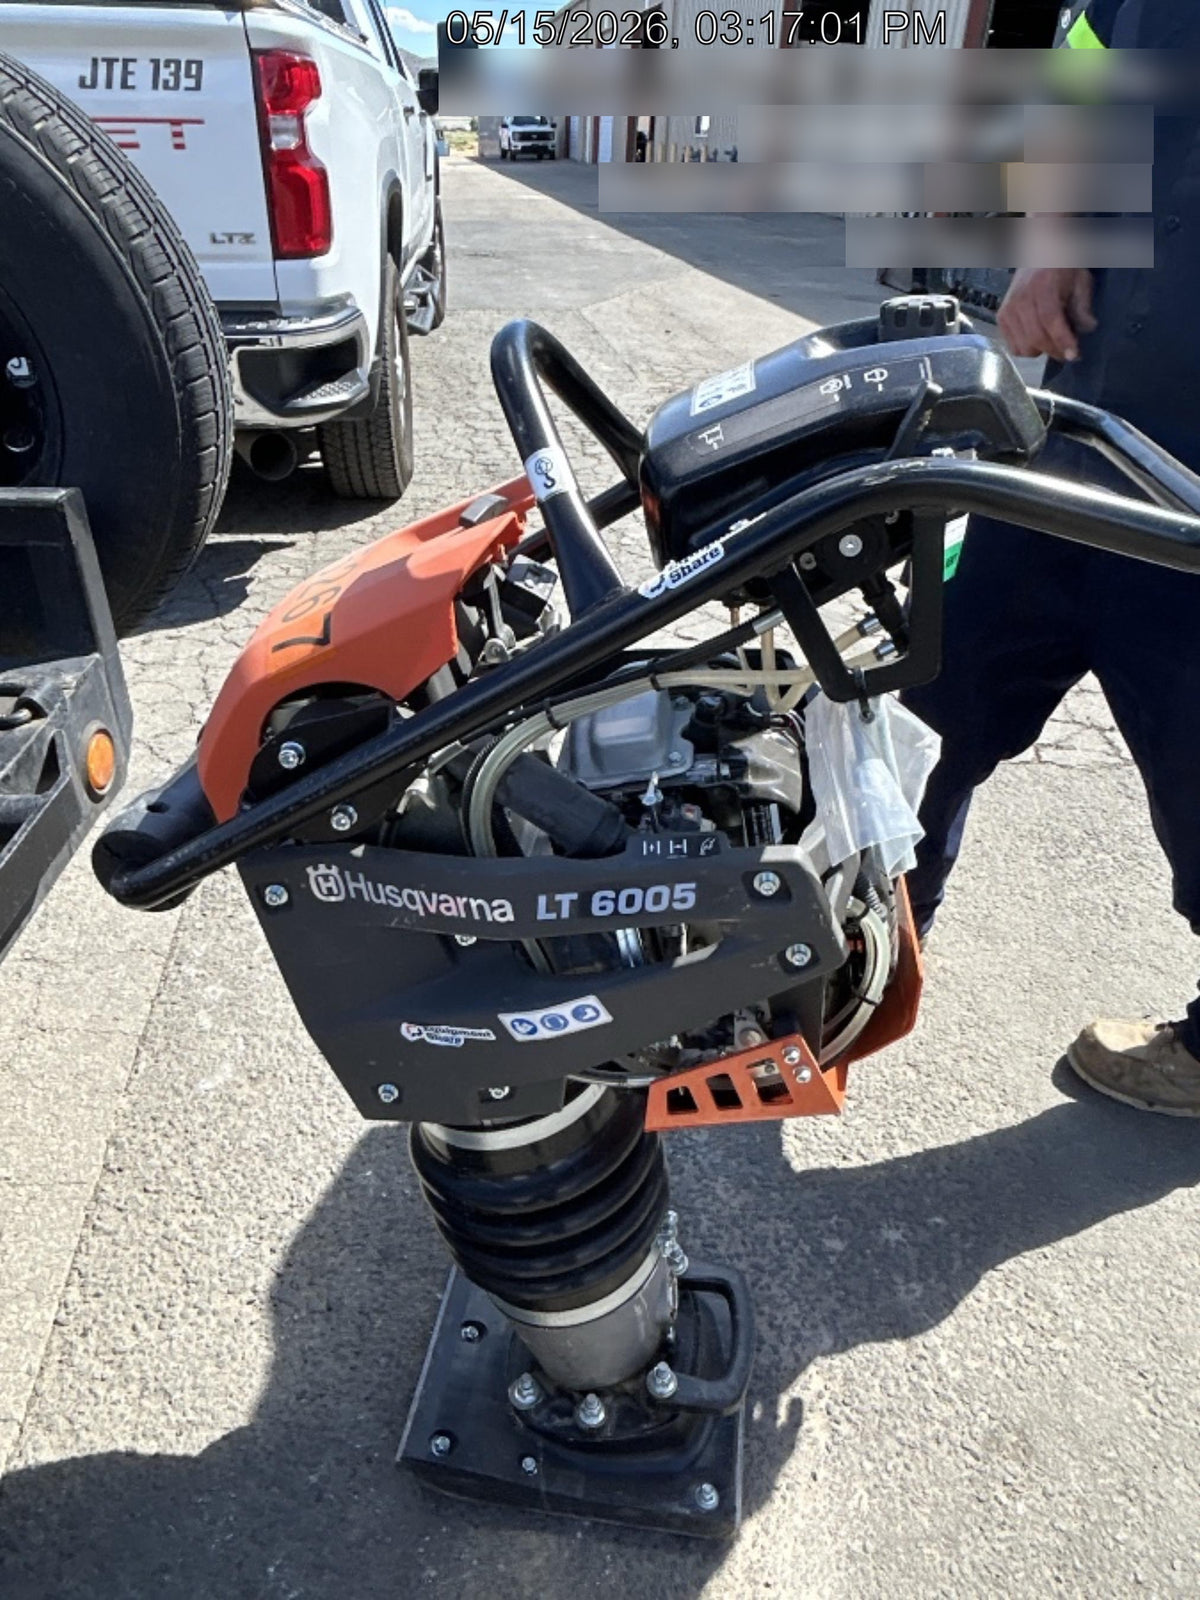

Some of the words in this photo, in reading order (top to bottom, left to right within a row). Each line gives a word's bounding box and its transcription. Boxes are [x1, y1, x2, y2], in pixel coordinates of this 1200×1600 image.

[78, 58, 136, 90] JTE
[151, 58, 204, 91] 139
[668, 547, 720, 584] Share
[344, 870, 515, 923] Husqvarna
[536, 893, 579, 921] LT
[590, 883, 697, 916] 6005
